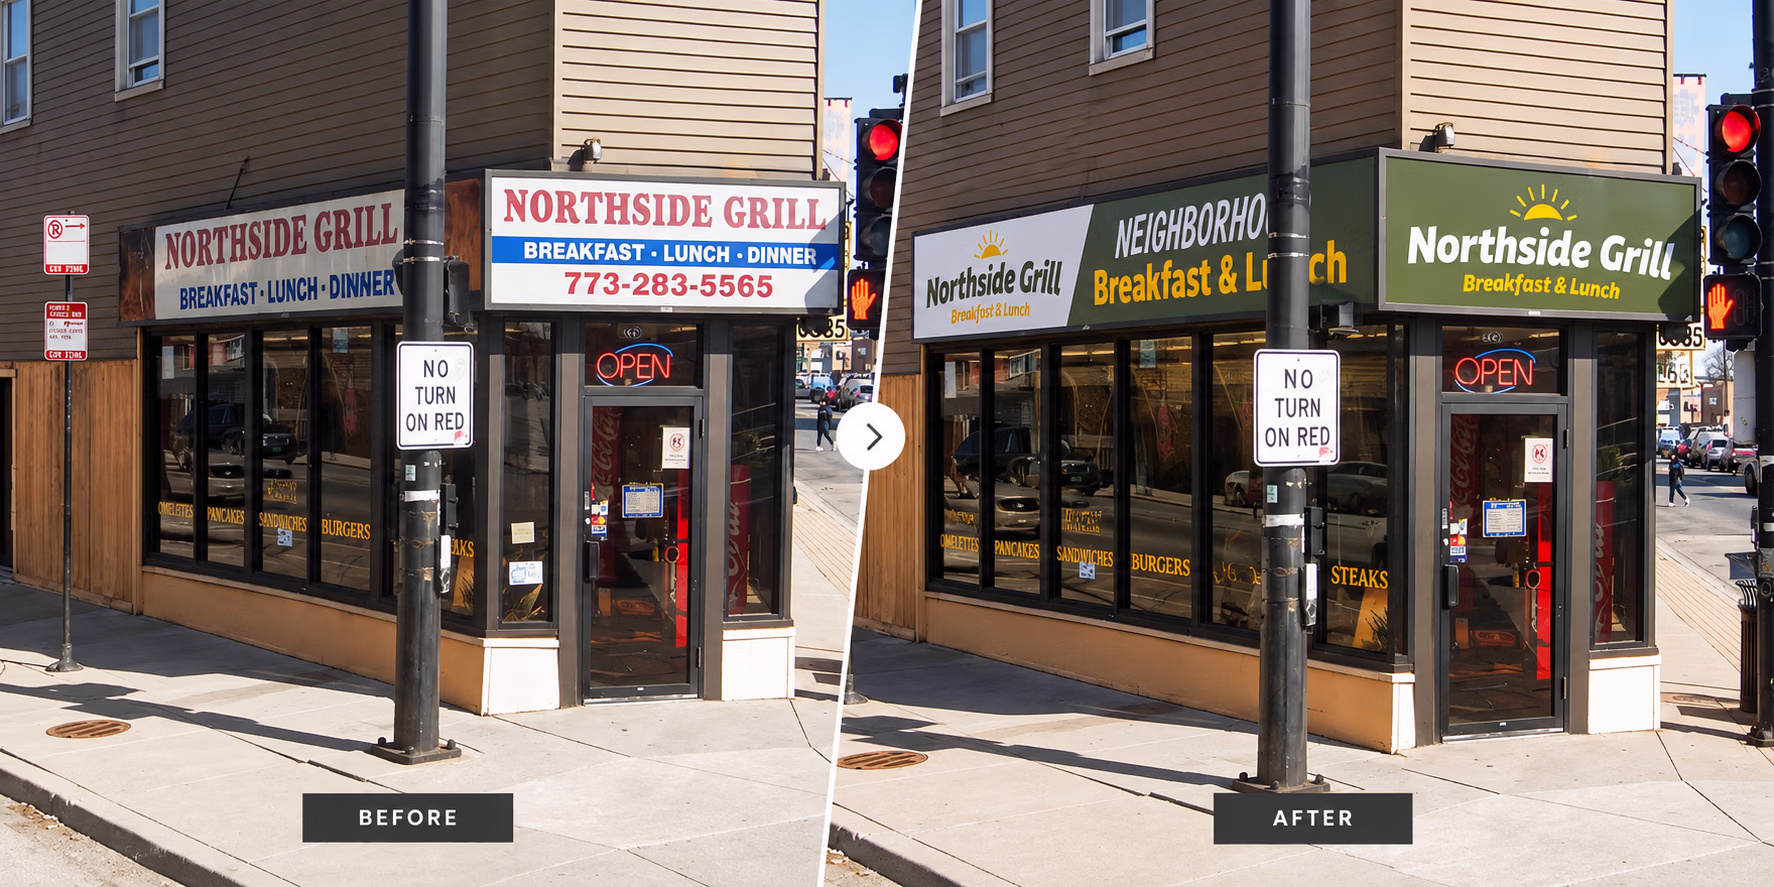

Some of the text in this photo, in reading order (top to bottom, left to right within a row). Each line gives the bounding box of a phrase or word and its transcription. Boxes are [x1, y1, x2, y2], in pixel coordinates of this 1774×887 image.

[504, 189, 827, 230] NORTHSIDE GRILL
[165, 202, 398, 270] NORTHSIDE GRILL
[1115, 192, 1269, 259] NEIGHBORHO
[523, 240, 818, 266] BREAKFAST LUNCH DINNER
[1408, 225, 1675, 281] Northside Grill
[564, 271, 774, 298] 773-283-5565
[926, 258, 1063, 309] Northside Grill
[1094, 239, 1347, 306] Breakfast & Lch
[179, 269, 395, 311] BREAKFAST LUNCH DINNER
[1463, 272, 1621, 300] Breakfast & Lunch
[951, 301, 1031, 325] Breakfast & Lunch
[424, 360, 449, 378] NO
[596, 352, 671, 380] OPEN
[1454, 356, 1533, 386] OPEN
[1285, 369, 1313, 389] NO
[415, 386, 456, 405] TURN
[1275, 398, 1321, 418] TURN
[406, 412, 464, 432] ON RED
[1265, 426, 1330, 448] ON RED
[207, 506, 245, 525] PANCAKES
[259, 511, 308, 532] SANDWICHES
[321, 518, 371, 540] BURGERS
[452, 538, 475, 558] AKS
[994, 539, 1041, 560] PANCAKES
[1056, 545, 1114, 568] SANDWICHES
[1130, 552, 1191, 577] BURGERS
[1330, 565, 1389, 591] STEAKS
